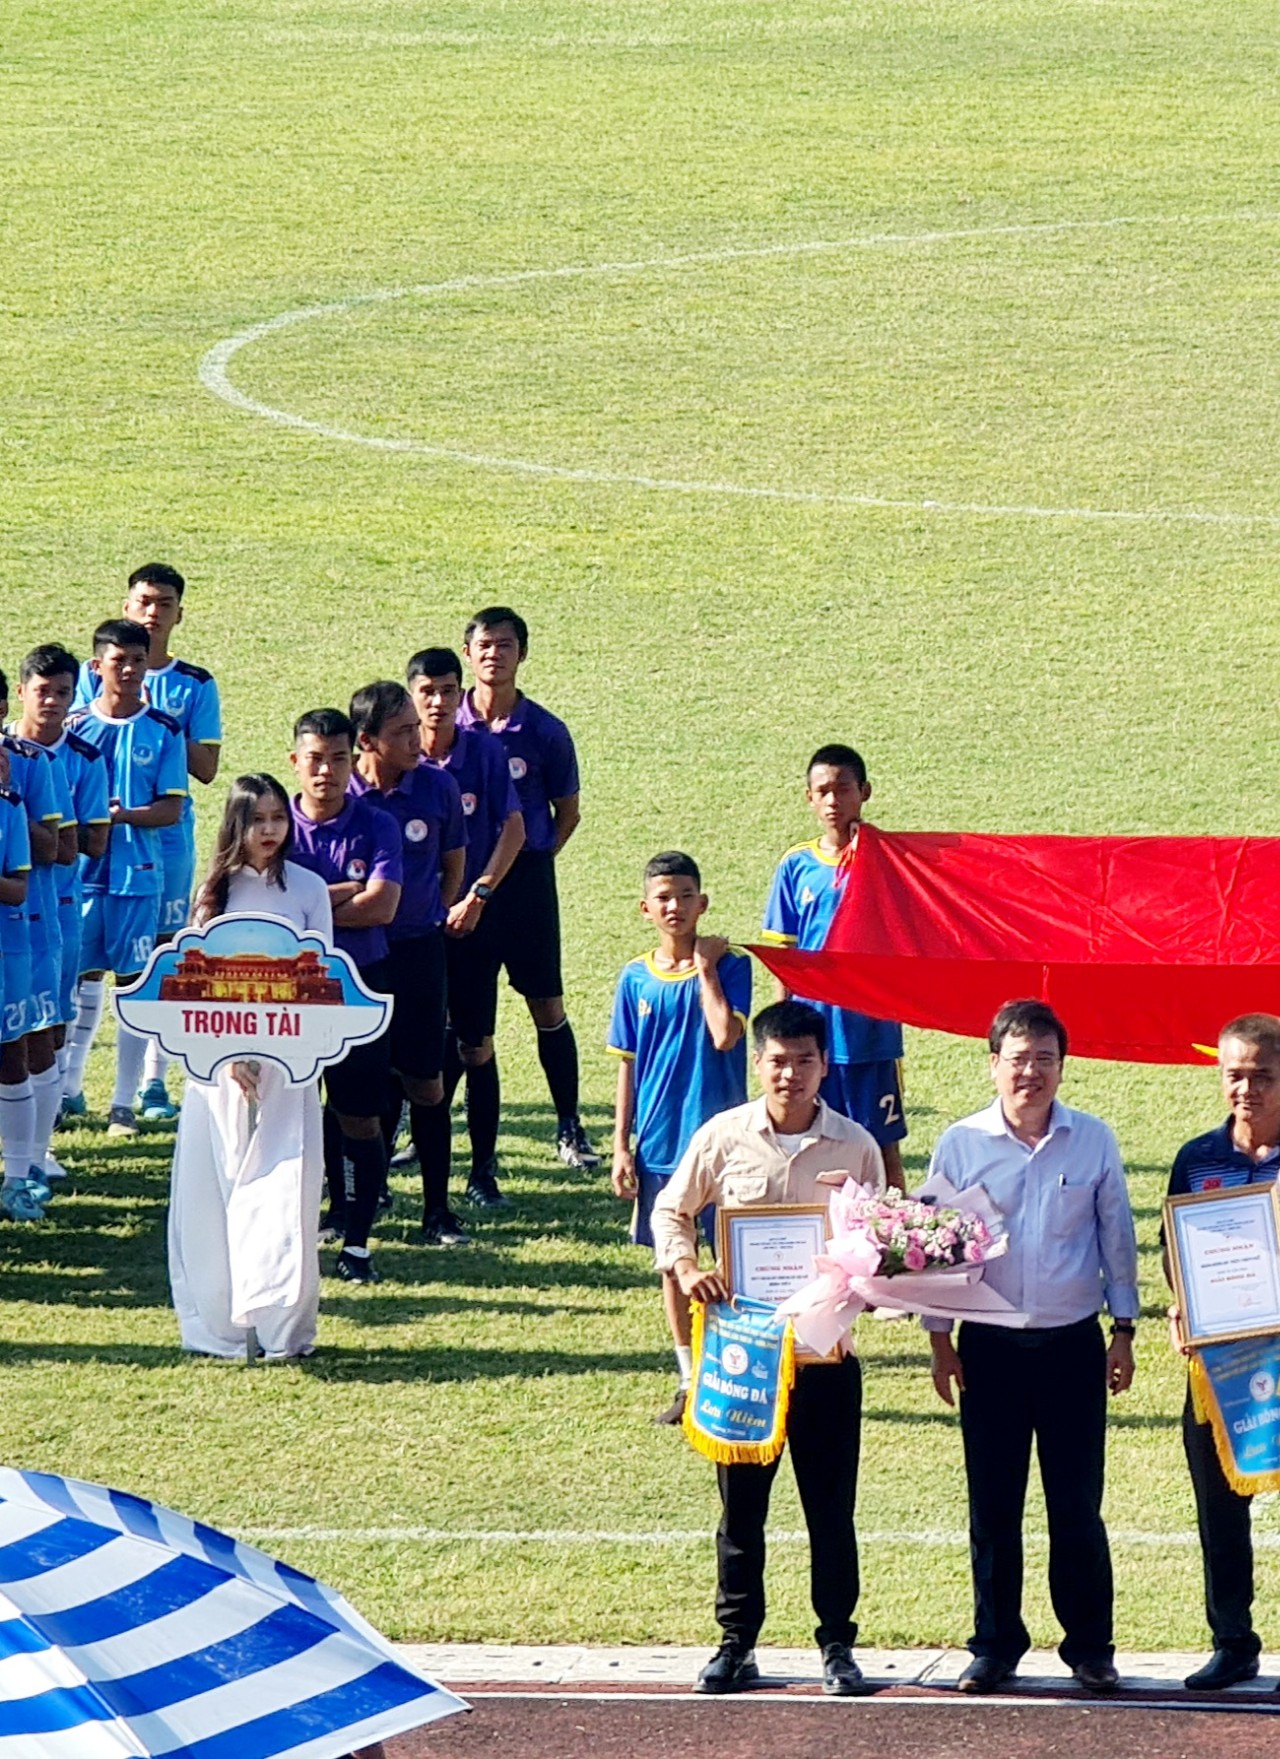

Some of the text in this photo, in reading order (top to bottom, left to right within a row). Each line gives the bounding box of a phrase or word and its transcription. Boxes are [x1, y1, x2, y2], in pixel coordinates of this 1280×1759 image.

[164, 898, 187, 926] 15
[31, 989, 57, 1021] 16
[181, 1006, 301, 1039] TRỌNG TÀI
[879, 1093, 900, 1127] 2
[720, 1378, 749, 1401] BÓNG
[750, 1387, 768, 1405] ĐÁ
